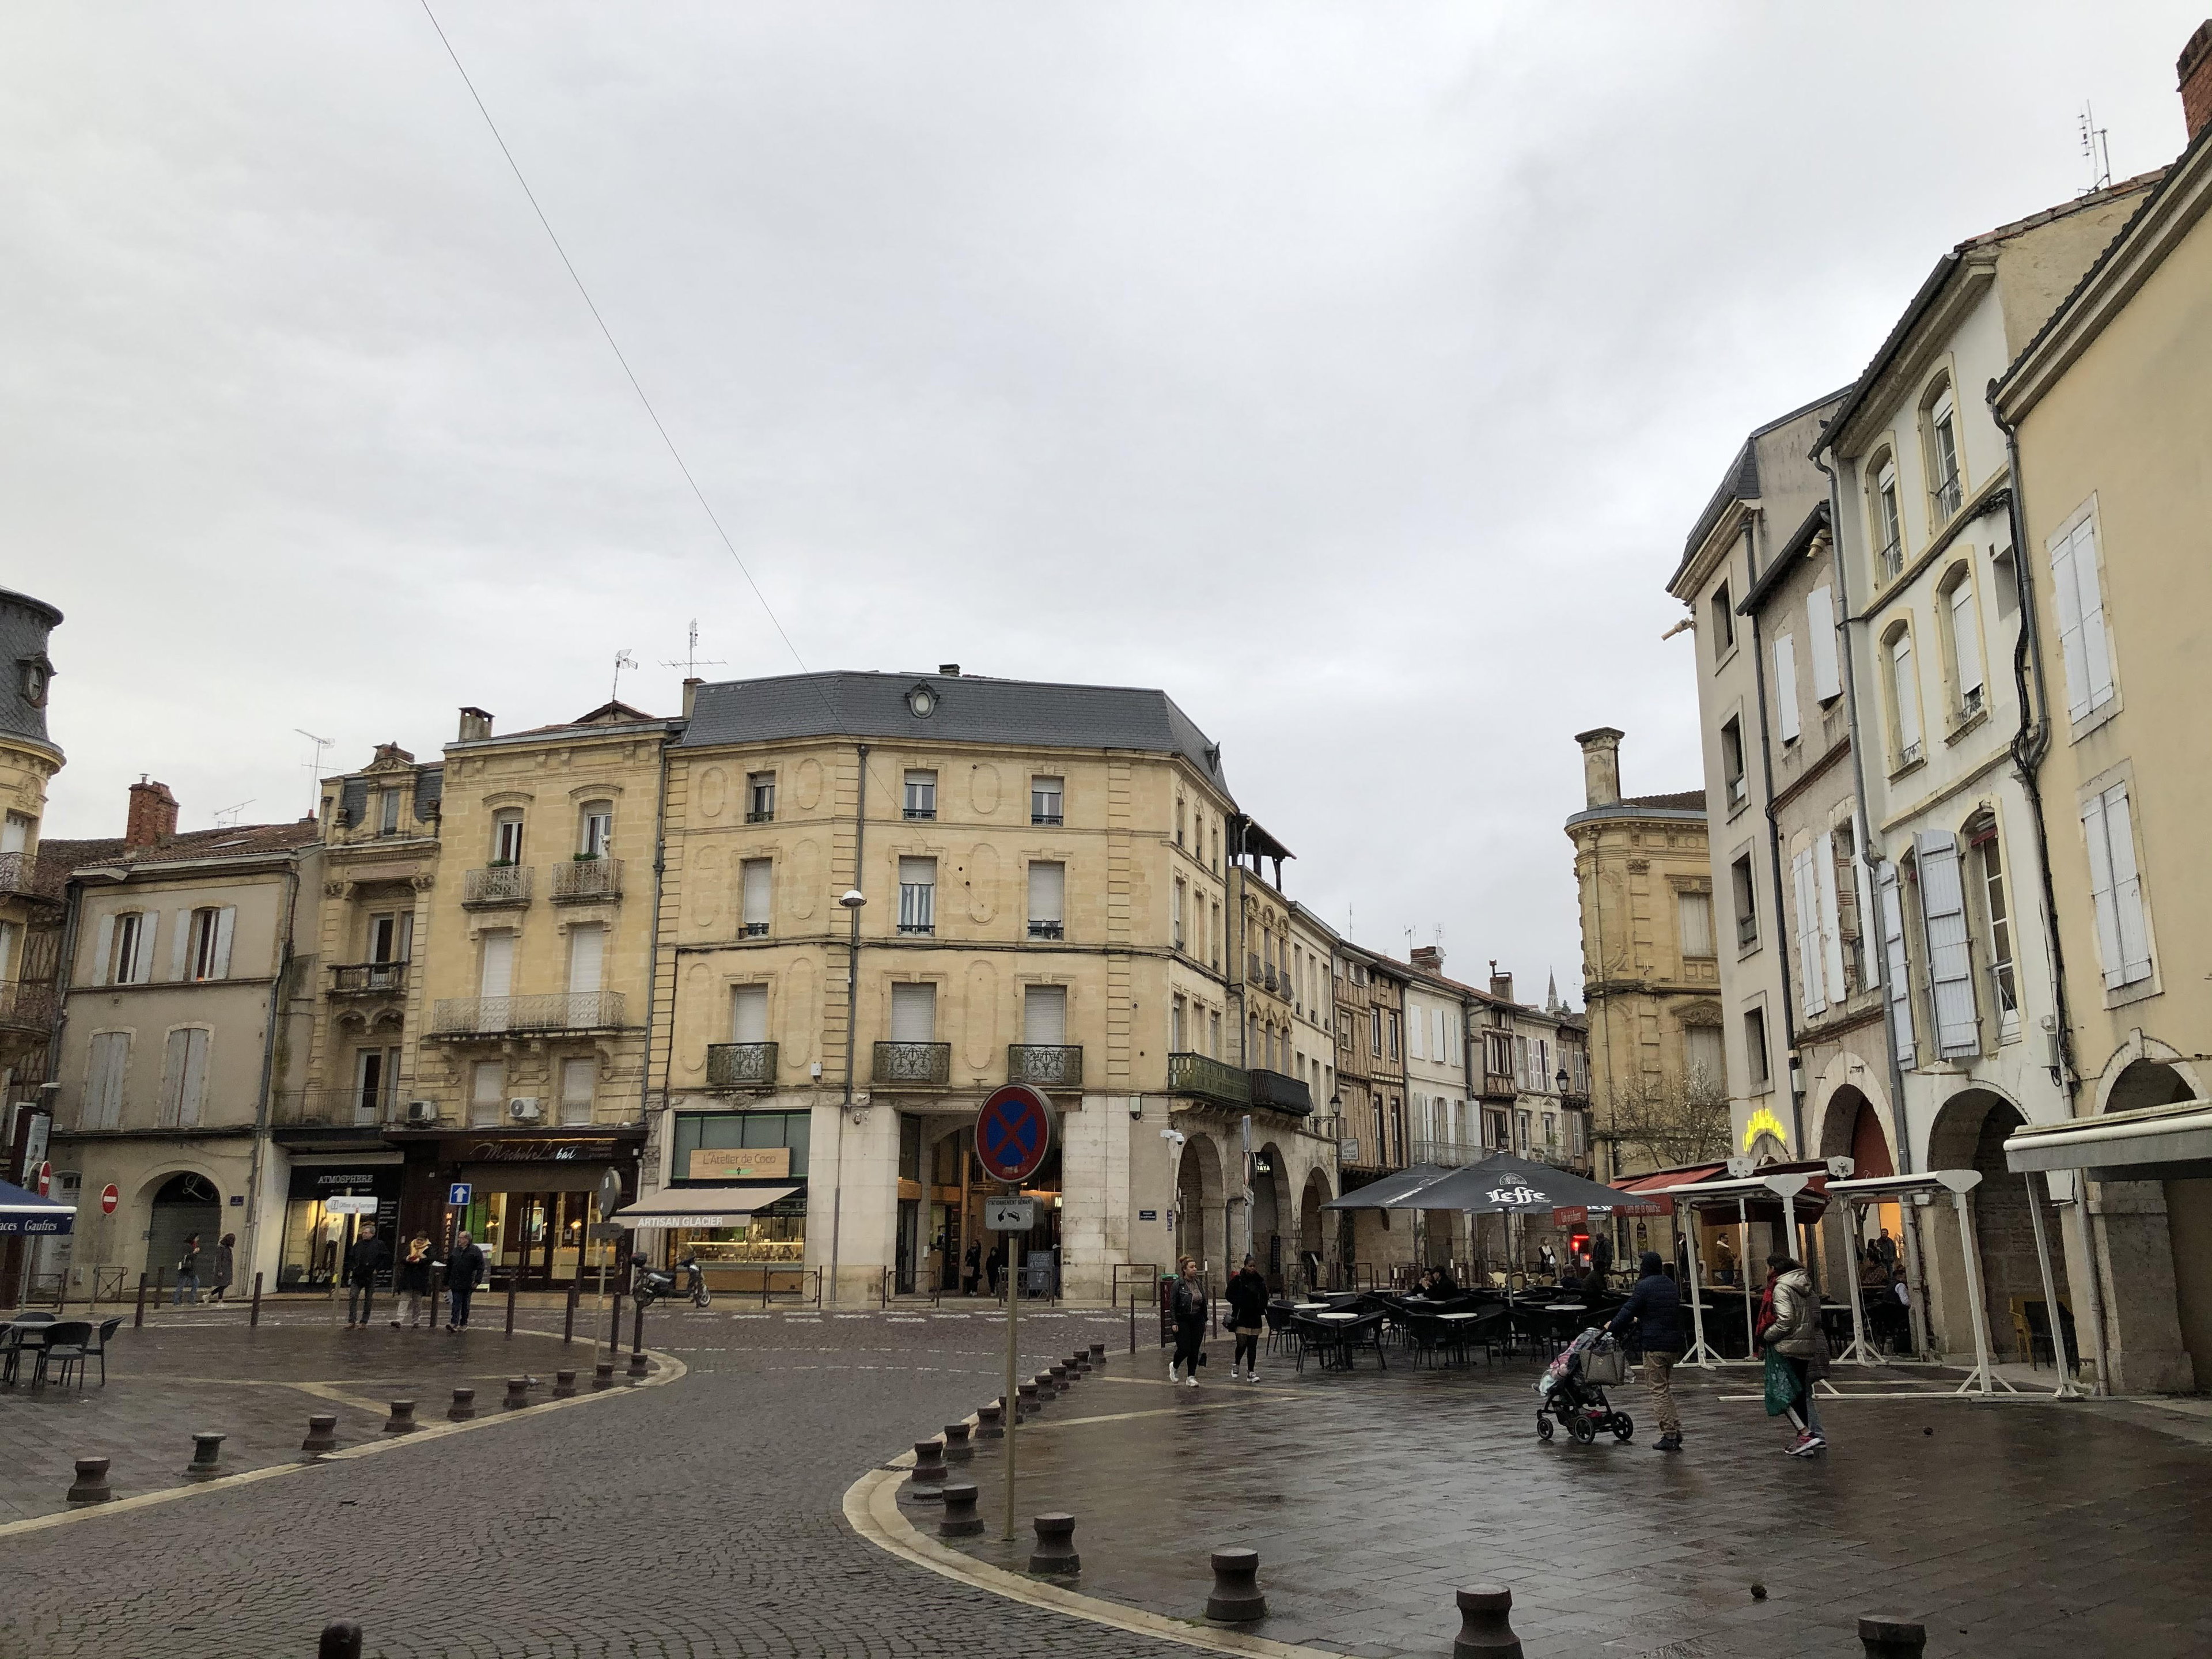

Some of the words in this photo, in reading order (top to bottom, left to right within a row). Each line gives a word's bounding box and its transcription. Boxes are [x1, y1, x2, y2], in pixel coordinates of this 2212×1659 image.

[703, 1153, 738, 1165] L'Atelier
[741, 1154, 752, 1164] de
[754, 1154, 777, 1164] Coco
[317, 1175, 374, 1184] ATMOSPHERE
[1485, 1187, 1546, 1205] Leffe
[24, 1219, 58, 1232] Gaufres
[638, 1217, 680, 1228] ARTISAN
[681, 1217, 723, 1226] GLACIER
